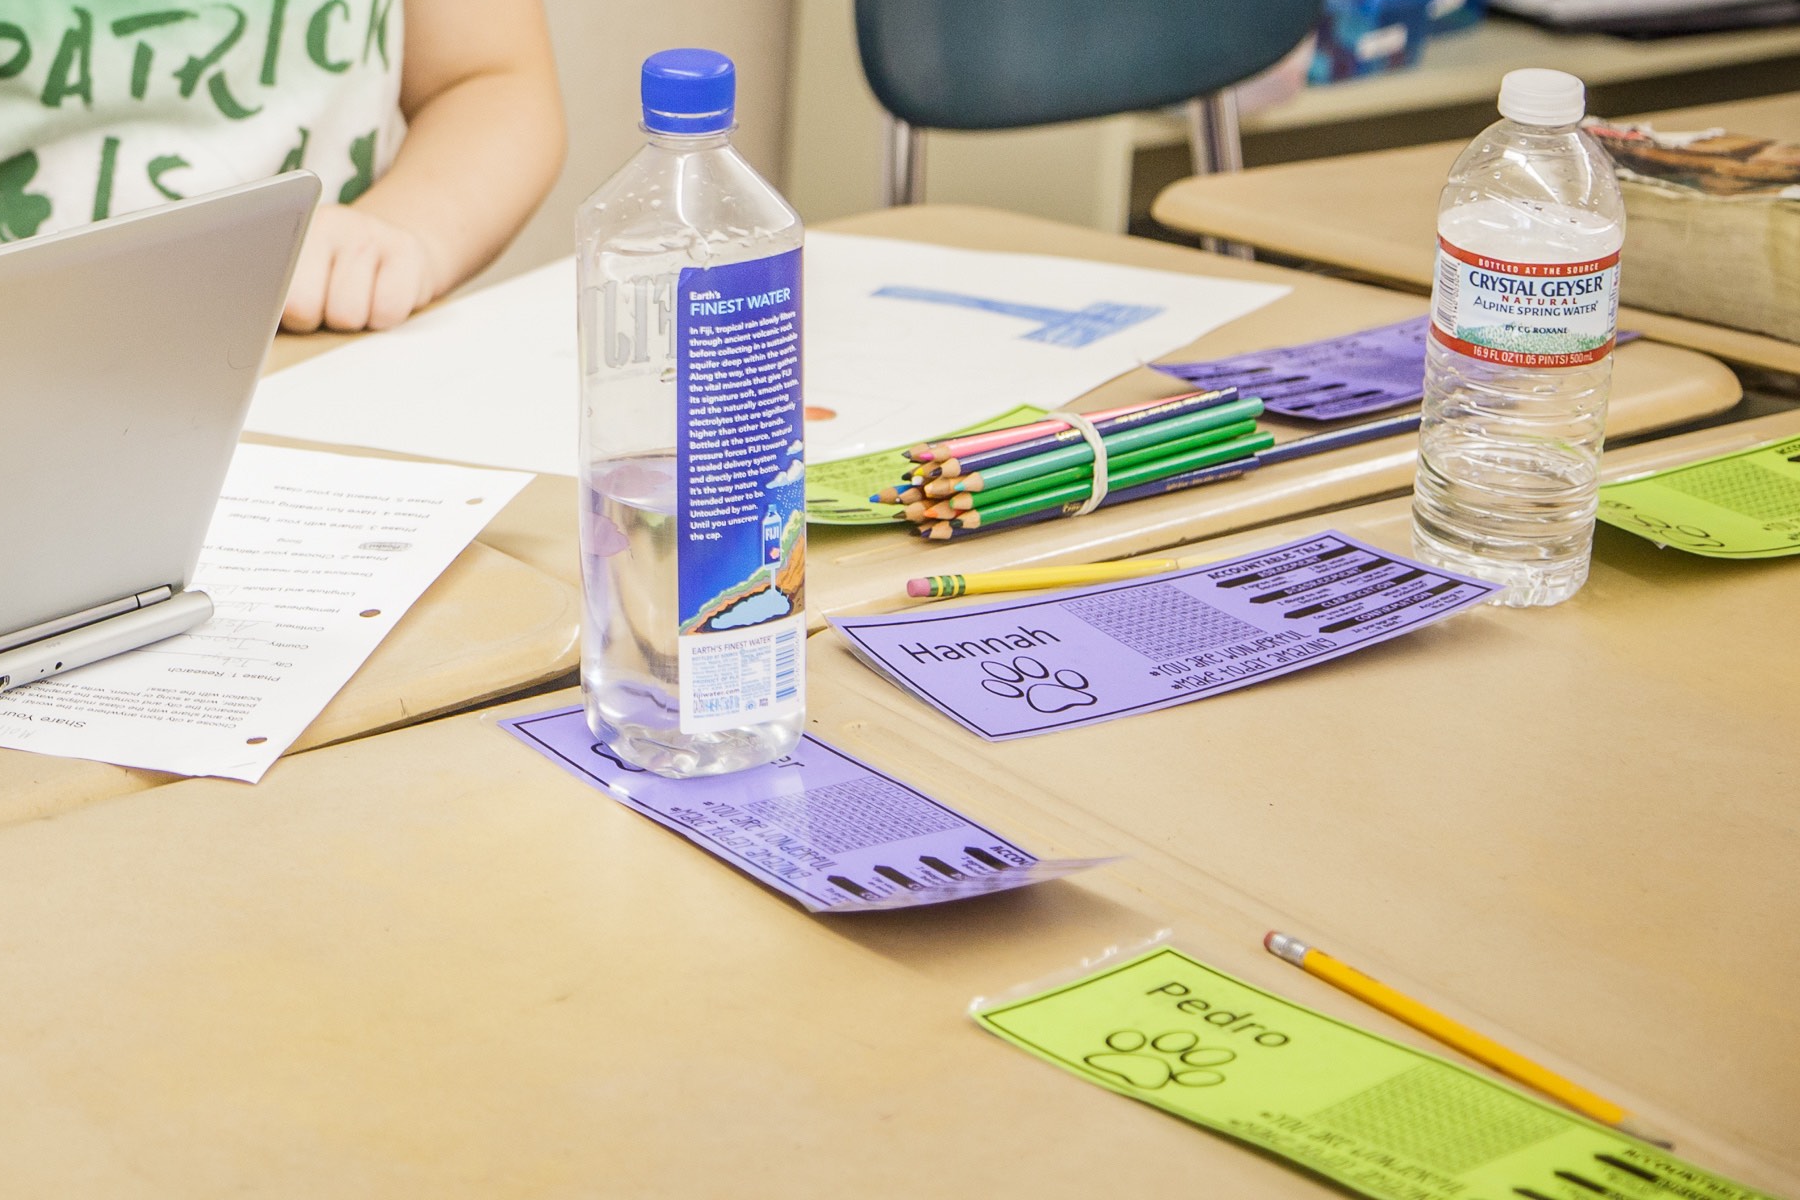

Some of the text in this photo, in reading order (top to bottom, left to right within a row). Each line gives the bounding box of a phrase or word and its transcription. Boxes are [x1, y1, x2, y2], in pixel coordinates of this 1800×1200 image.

[1478, 258, 1519, 273] BOTTLED
[1543, 266, 1561, 275] THE
[1566, 262, 1599, 275] SOURCE
[1469, 270, 1537, 297] CRYSTAL
[690, 290, 721, 301] Earth's
[690, 287, 791, 316] FINEST WATER
[1501, 294, 1578, 306] NATURAL
[1473, 296, 1597, 316] ALPINE SPRING WATER
[700, 326, 714, 336] Fiji,
[715, 322, 743, 334] tropical
[745, 320, 758, 329] rain
[759, 316, 779, 326] slowly
[1533, 327, 1568, 335] ROXANE
[689, 337, 722, 347] through
[724, 333, 751, 344] ancient
[752, 327, 779, 339] volcanic
[689, 350, 716, 358] before
[718, 345, 752, 356] collecting
[689, 360, 720, 370] aquifer
[721, 358, 742, 368] deep
[743, 354, 766, 363] within
[767, 350, 779, 359] the
[1473, 345, 1488, 359] 16.9
[1501, 352, 1516, 363] OZ
[1515, 354, 1537, 365] (1.05
[1538, 354, 1569, 365] PINTS)
[1570, 352, 1593, 364] 500mL
[689, 372, 713, 382] Along
[714, 370, 727, 379] the
[745, 366, 757, 375] the
[758, 362, 777, 372] water
[689, 384, 703, 392] the
[705, 382, 721, 392] vital
[722, 379, 752, 390] minerals
[753, 376, 767, 384] that
[768, 372, 781, 383] give
[689, 395, 700, 404] its
[702, 392, 738, 405] signature
[758, 383, 783, 395] smooth
[689, 393, 789, 415] and the naturally occurring
[689, 416, 733, 427] electrolytes
[734, 413, 749, 422] that
[689, 430, 717, 439] higher
[718, 427, 736, 436] than
[738, 424, 758, 433] other
[689, 440, 720, 449] Bottled
[731, 437, 743, 445] the
[771, 425, 793, 438] natural
[689, 439, 787, 463] pressure forces FIJI towards
[697, 454, 777, 472] sealed delivery system
[689, 475, 704, 484] and
[705, 473, 732, 482] directly
[748, 468, 759, 477] the
[690, 480, 757, 495] It's the way nature
[725, 494, 745, 503] water
[690, 507, 731, 518] Untouched
[690, 515, 759, 530] Until you unscrew
[690, 532, 722, 541] the cap.
[765, 526, 780, 541] FIJI
[1208, 543, 1330, 579] ACCOUNTABLE TALK
[692, 636, 771, 655] EARTH'S FINEST WATER
[898, 625, 1061, 664] Hannah
[167, 667, 281, 682] Phase Research
[693, 688, 740, 699] fijiwater.com
[40, 716, 86, 729] Share
[1145, 982, 1291, 1047] Pedro
